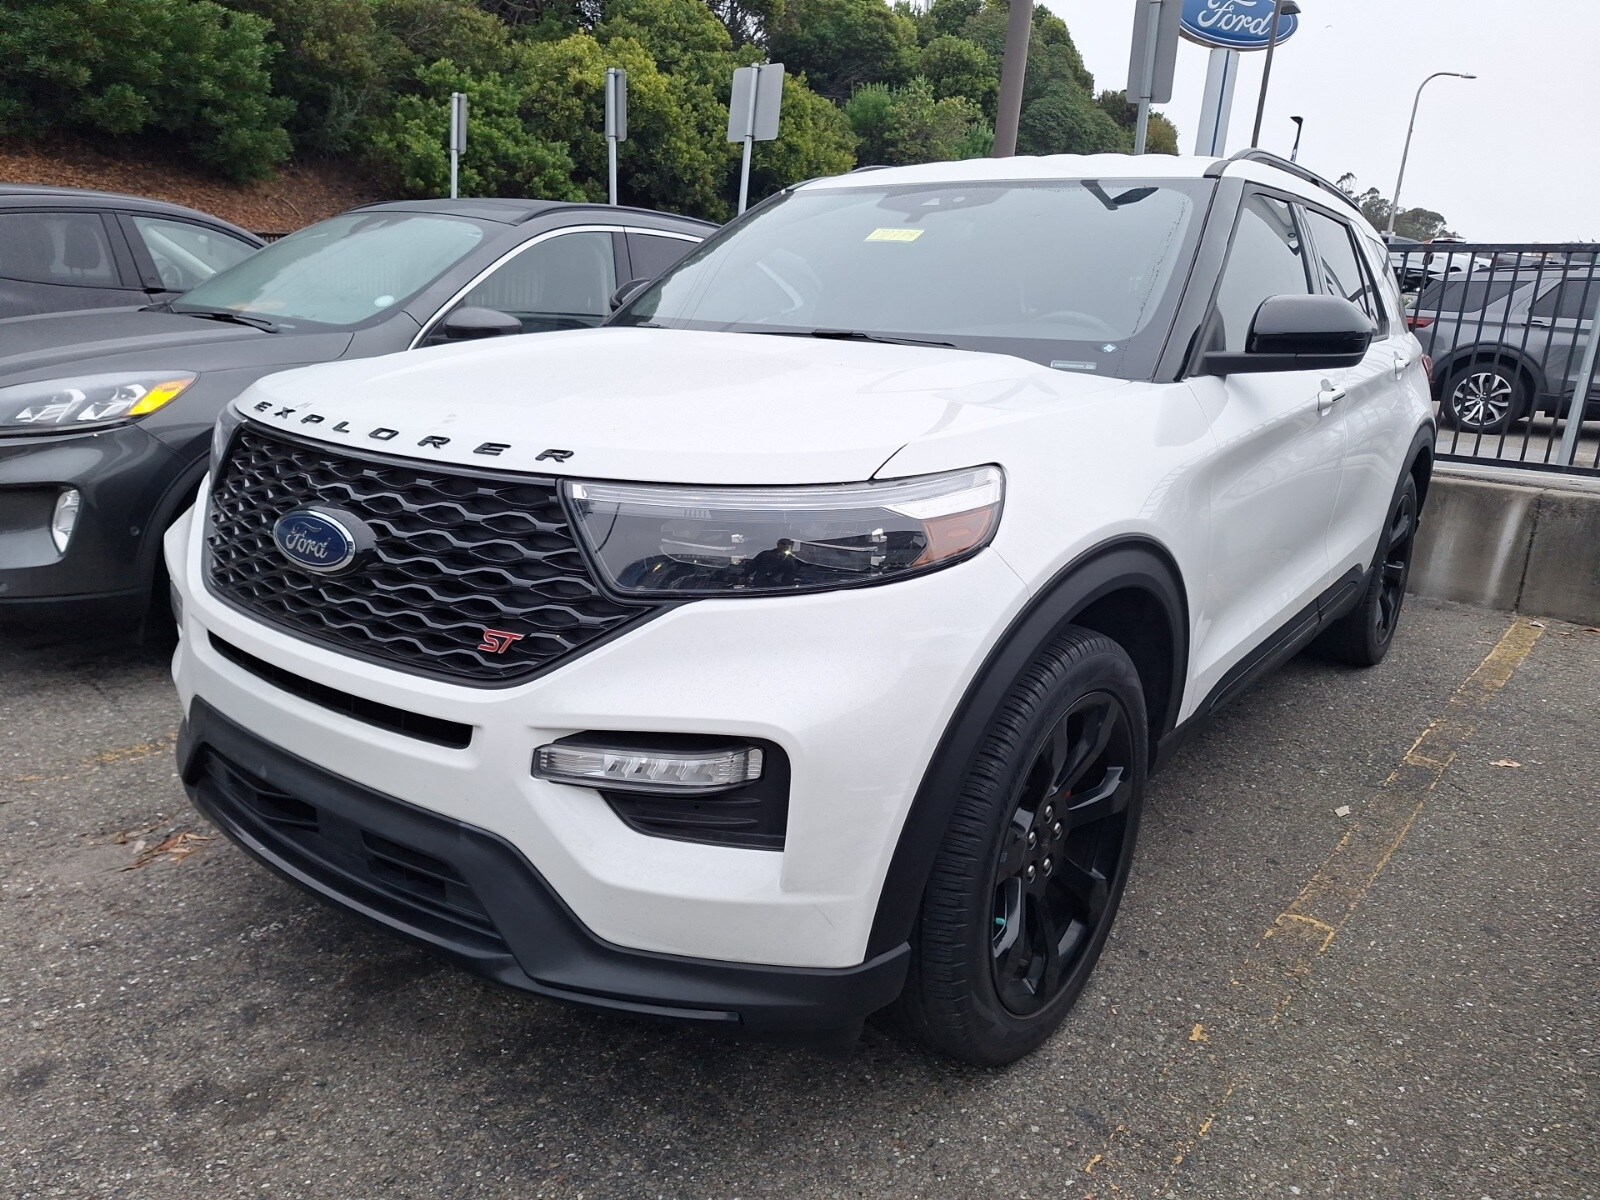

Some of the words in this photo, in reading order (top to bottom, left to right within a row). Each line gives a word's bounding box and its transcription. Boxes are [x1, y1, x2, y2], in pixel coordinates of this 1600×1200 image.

[1197, 0, 1274, 36] Ford
[253, 401, 574, 463] EXPLORER
[285, 521, 332, 559] Ford
[477, 628, 526, 654] ST
